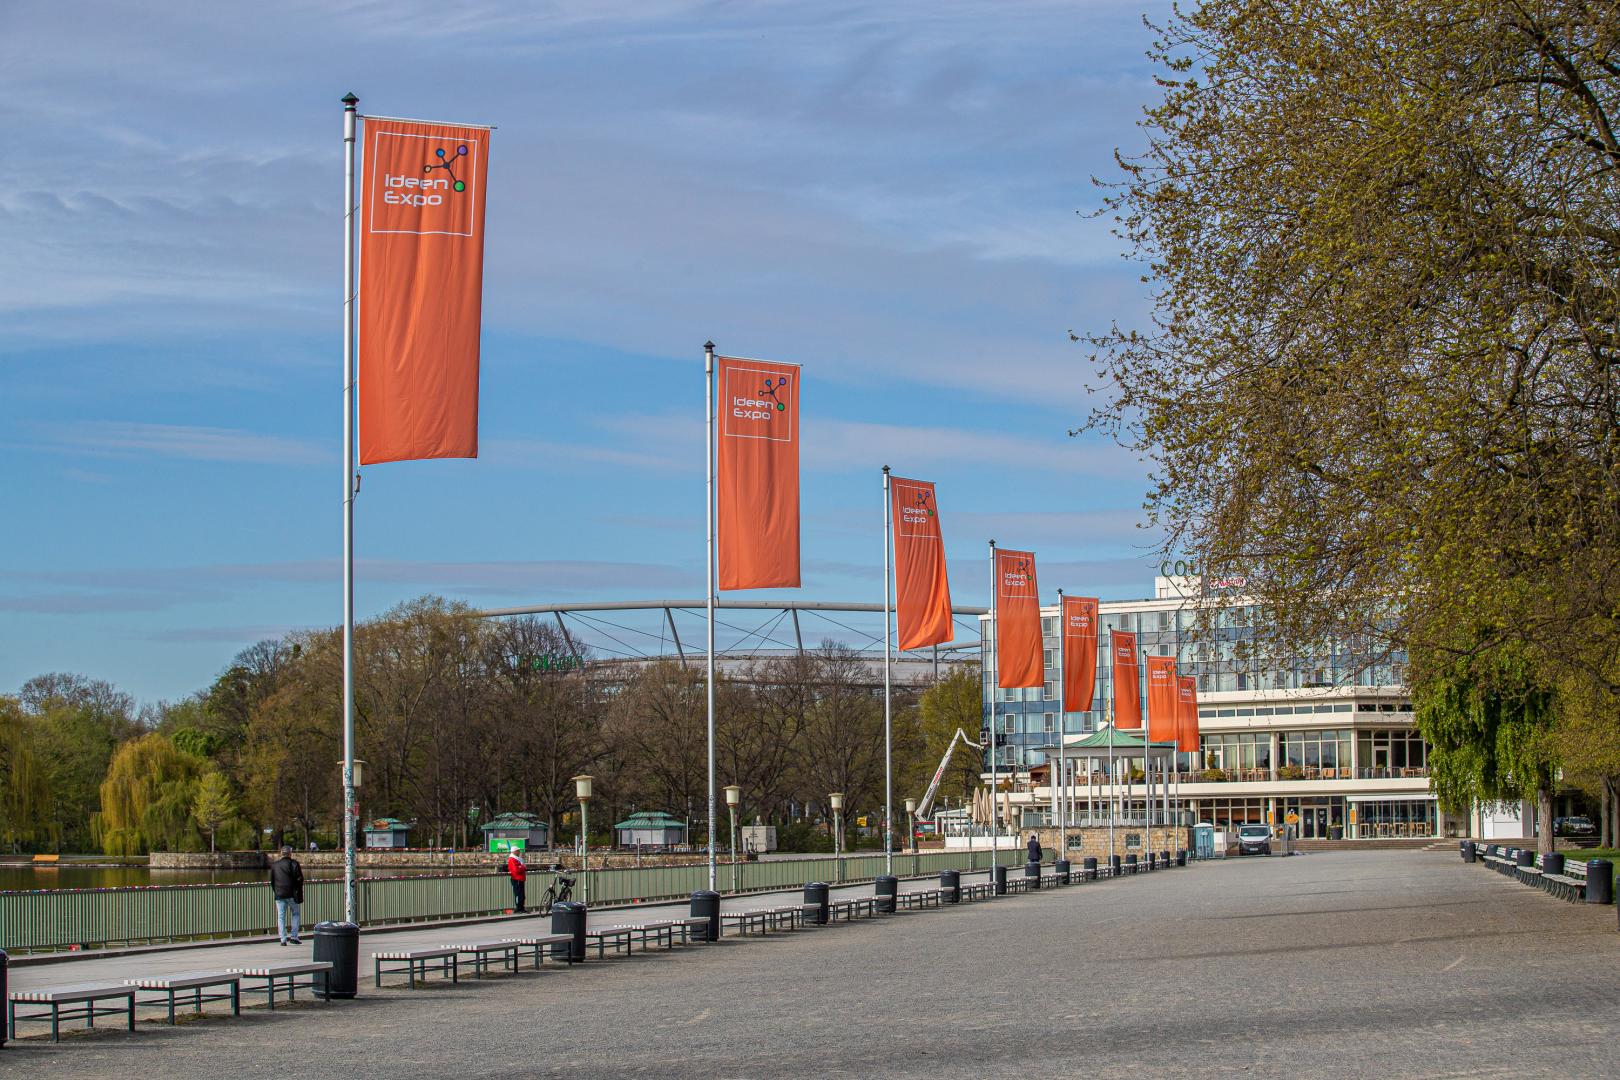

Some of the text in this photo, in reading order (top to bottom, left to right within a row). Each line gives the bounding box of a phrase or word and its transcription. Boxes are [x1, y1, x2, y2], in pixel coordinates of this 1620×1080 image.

[384, 174, 449, 190] Ideen
[384, 191, 443, 207] Expo
[733, 396, 774, 410] Ideen
[733, 408, 771, 420] Expo
[903, 514, 927, 524] Expo
